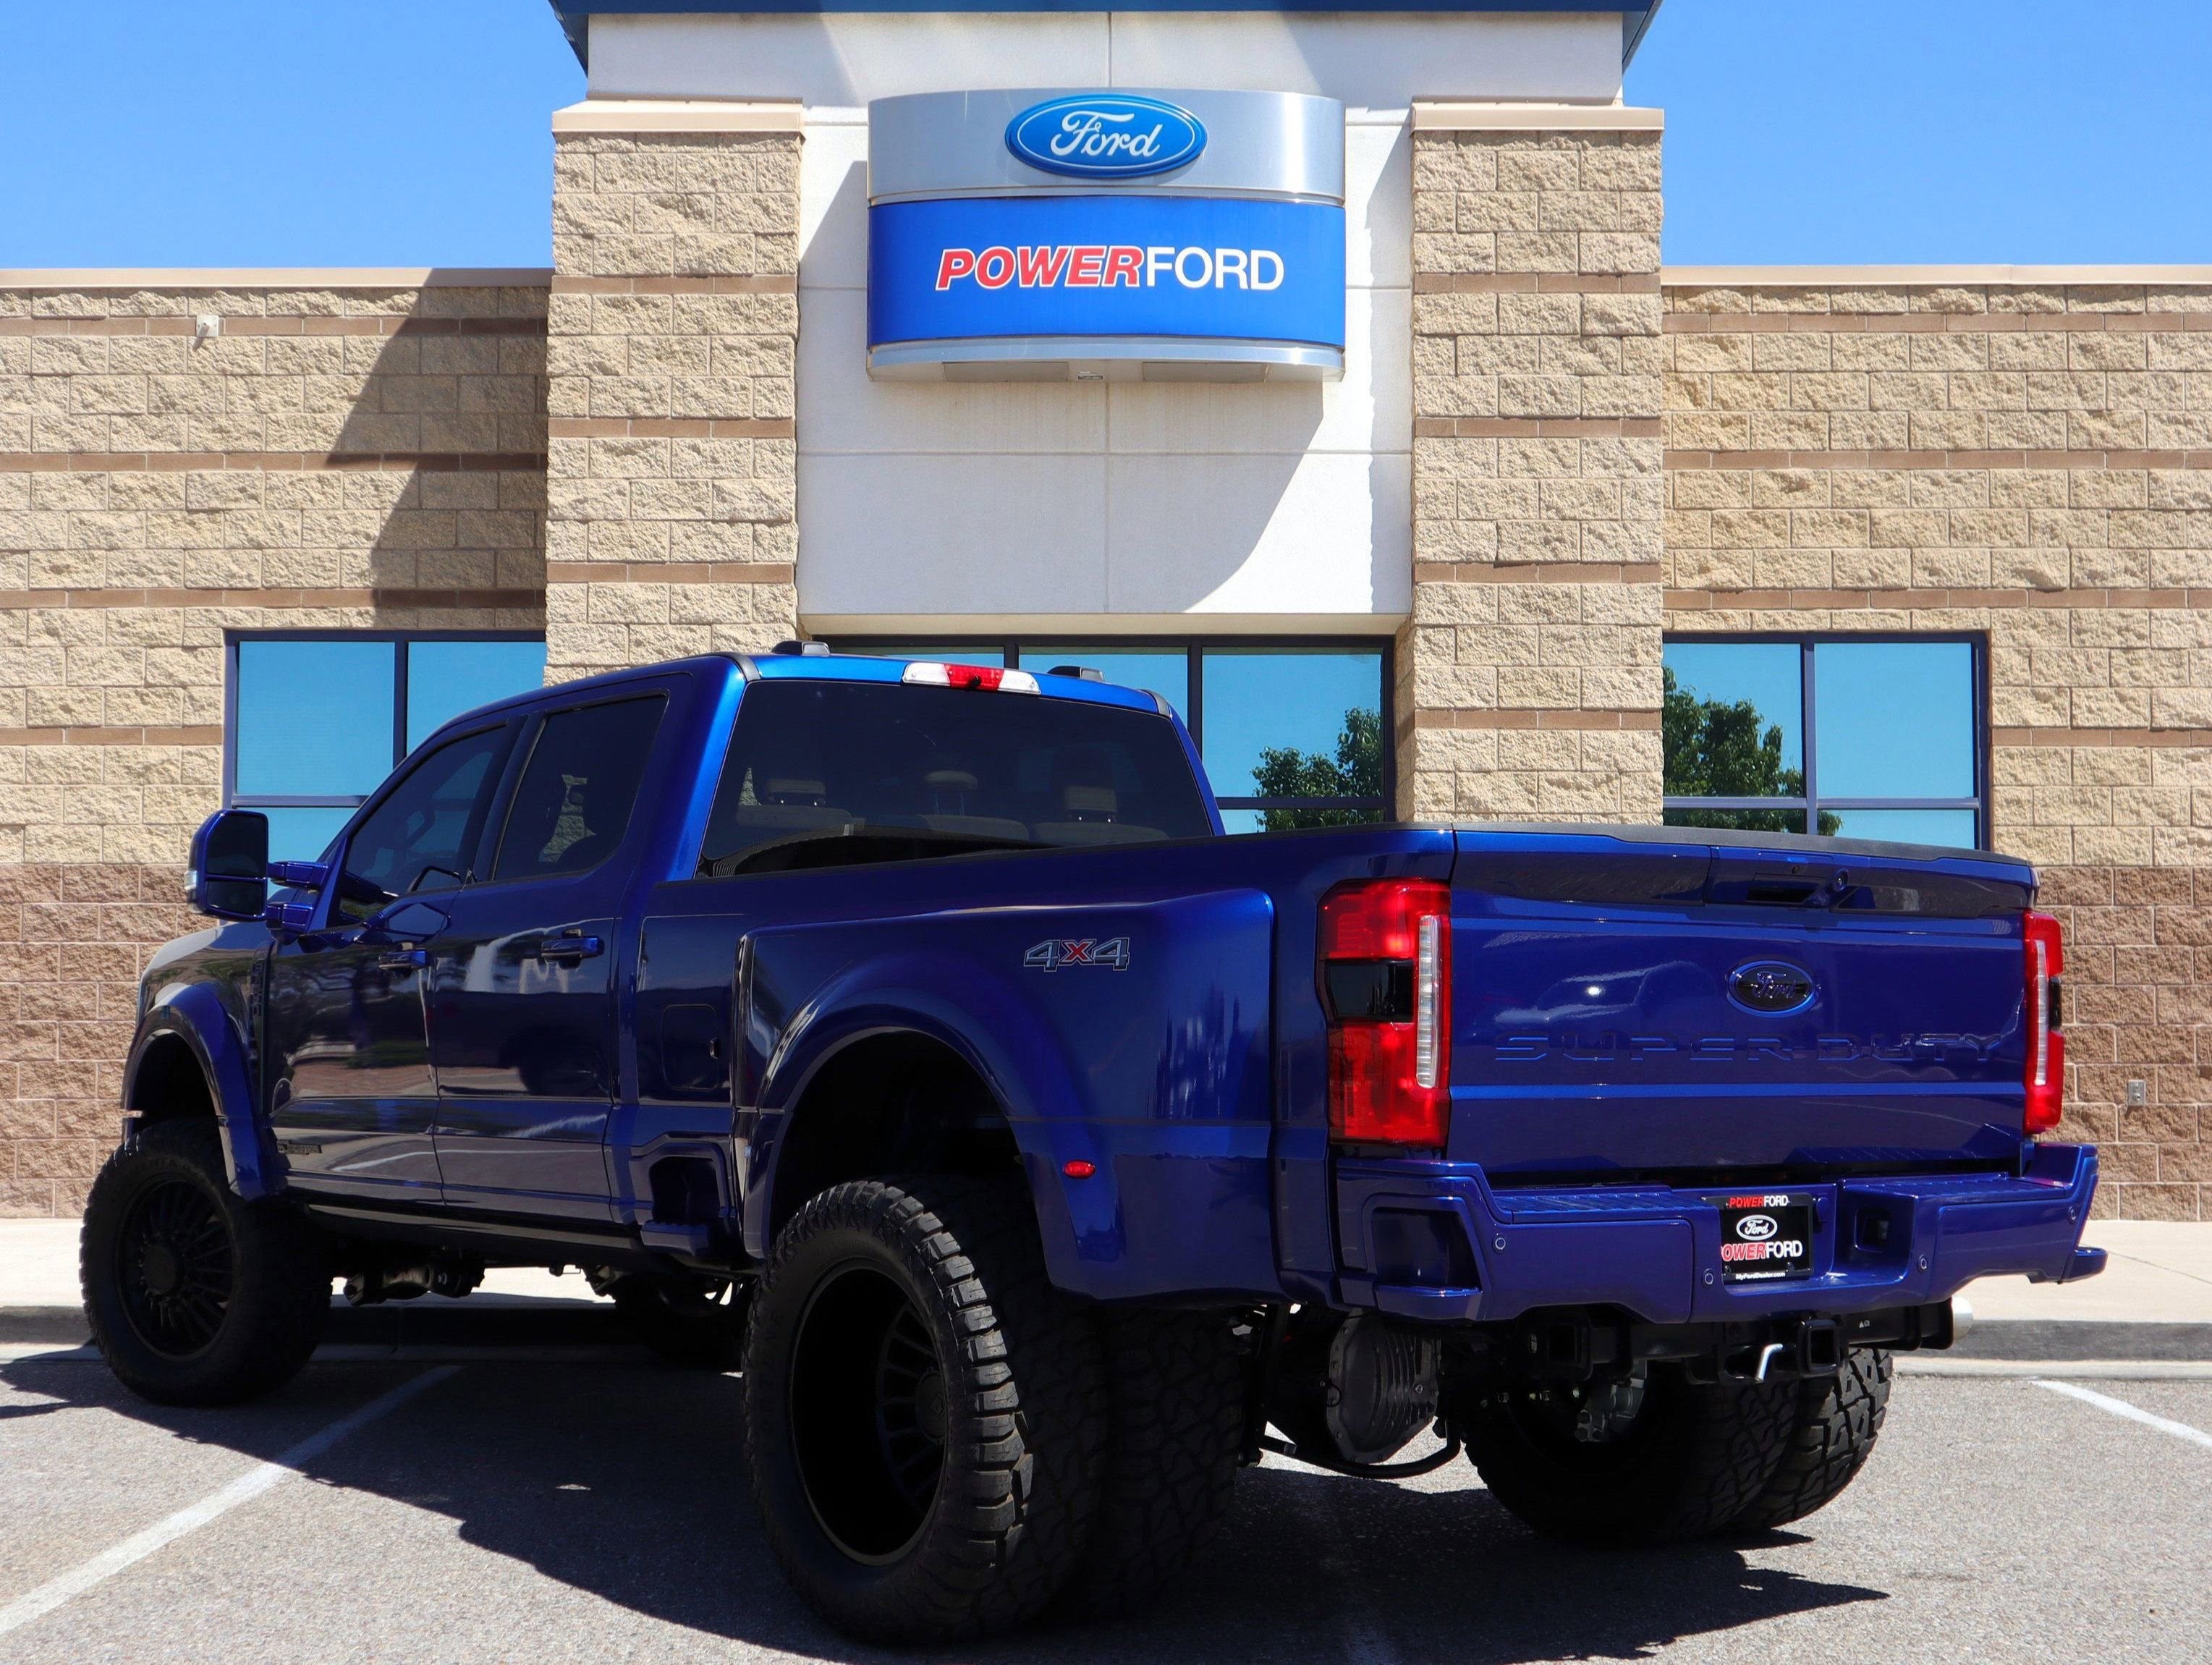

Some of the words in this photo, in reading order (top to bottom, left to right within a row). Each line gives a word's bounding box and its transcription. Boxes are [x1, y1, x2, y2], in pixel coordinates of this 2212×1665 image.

[1050, 110, 1162, 158] Ford
[935, 245, 1285, 291] POWERFORD
[1494, 1029, 1794, 1062] SUPER
[1818, 1033, 2002, 1062] DUTY
[1729, 1195, 1789, 1208] POWERFORD
[1745, 1219, 1769, 1235] Ford
[1721, 1240, 1803, 1261] OWERFORD
